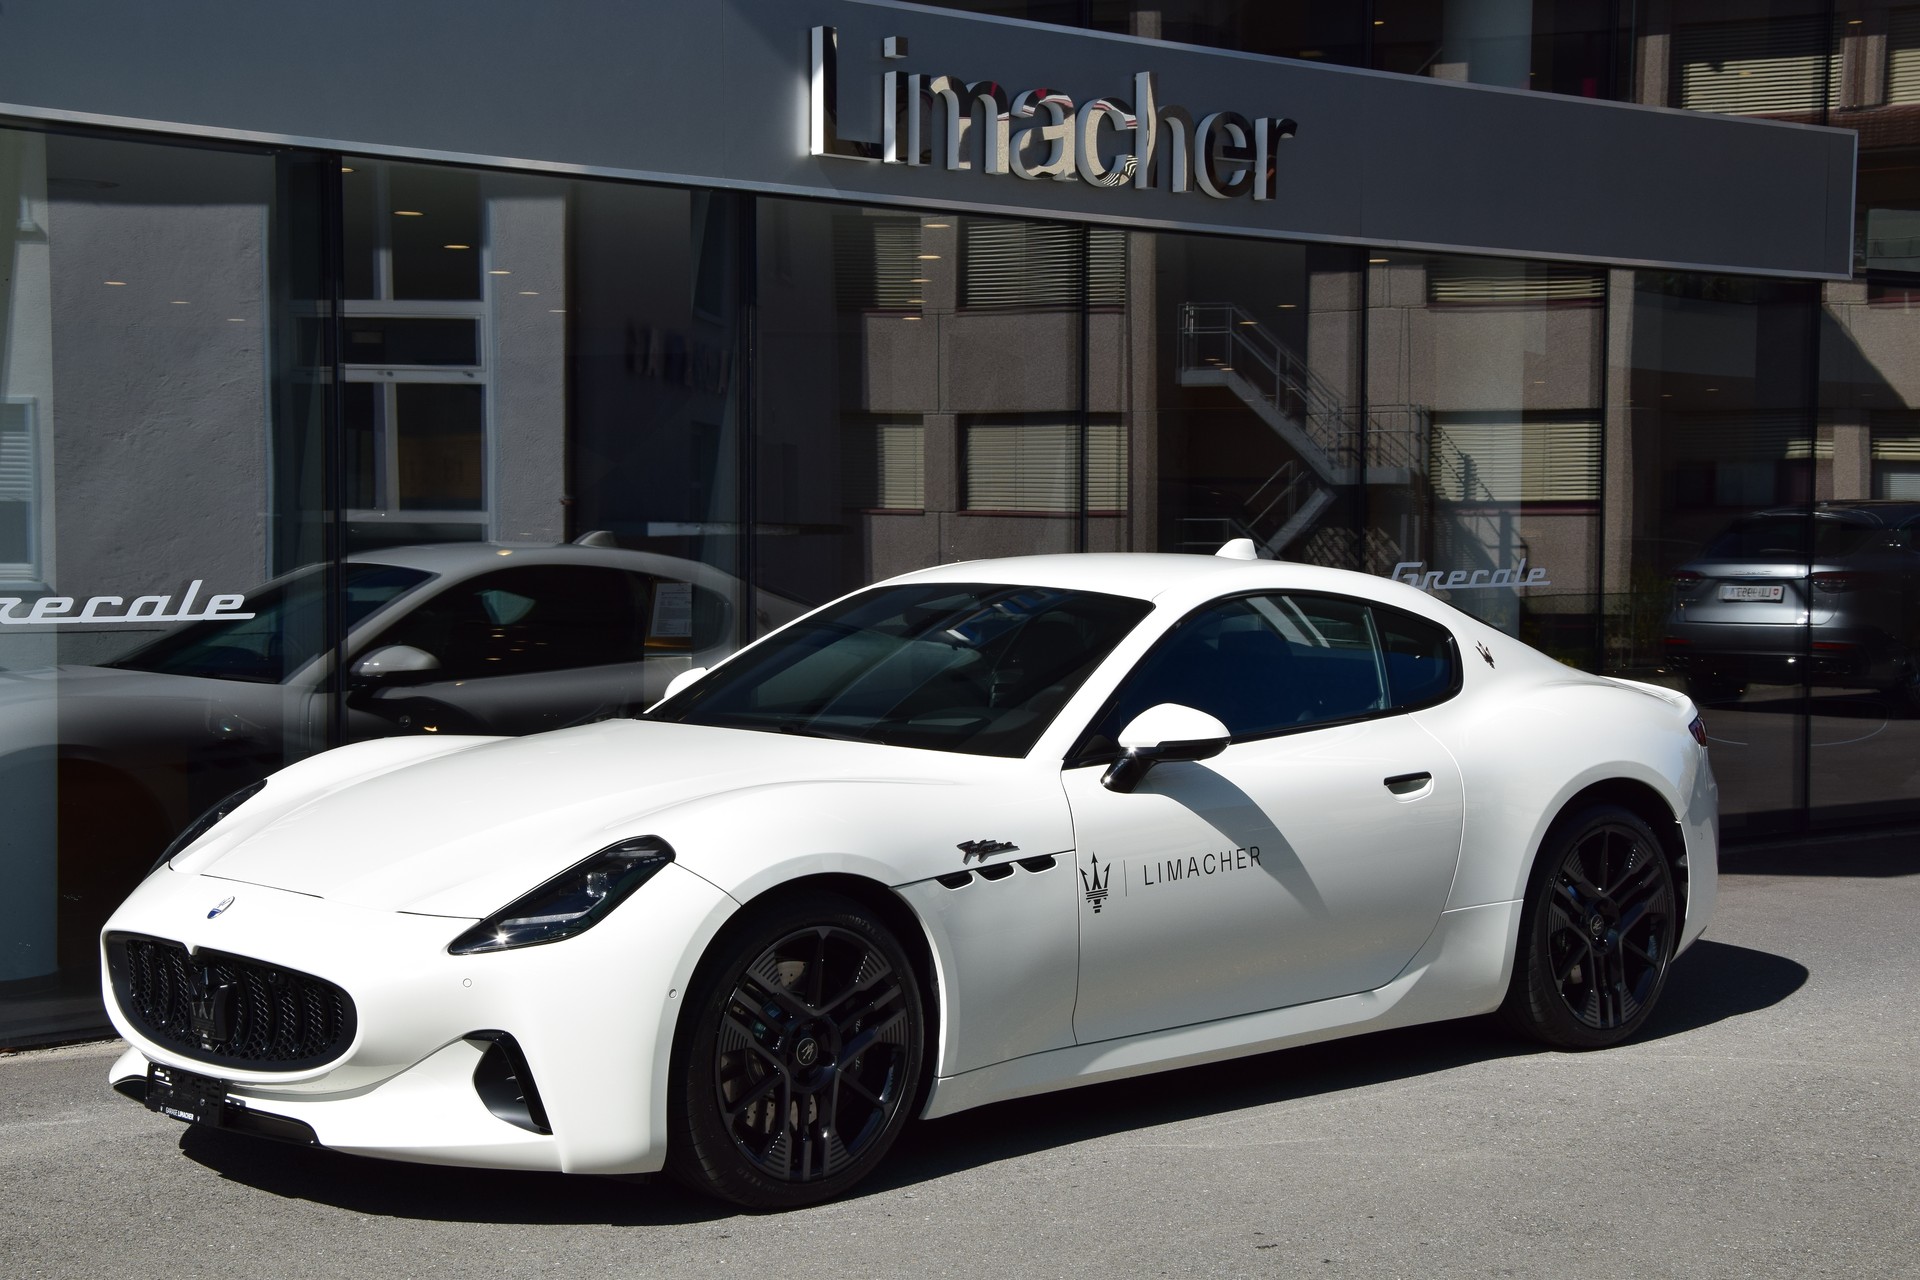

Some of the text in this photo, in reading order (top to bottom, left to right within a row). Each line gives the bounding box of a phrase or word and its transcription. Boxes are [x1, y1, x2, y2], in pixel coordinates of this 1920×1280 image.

[811, 26, 1298, 200] Limacher
[1391, 558, 1551, 590] Grecale
[1143, 846, 1262, 886] LIMACHER
